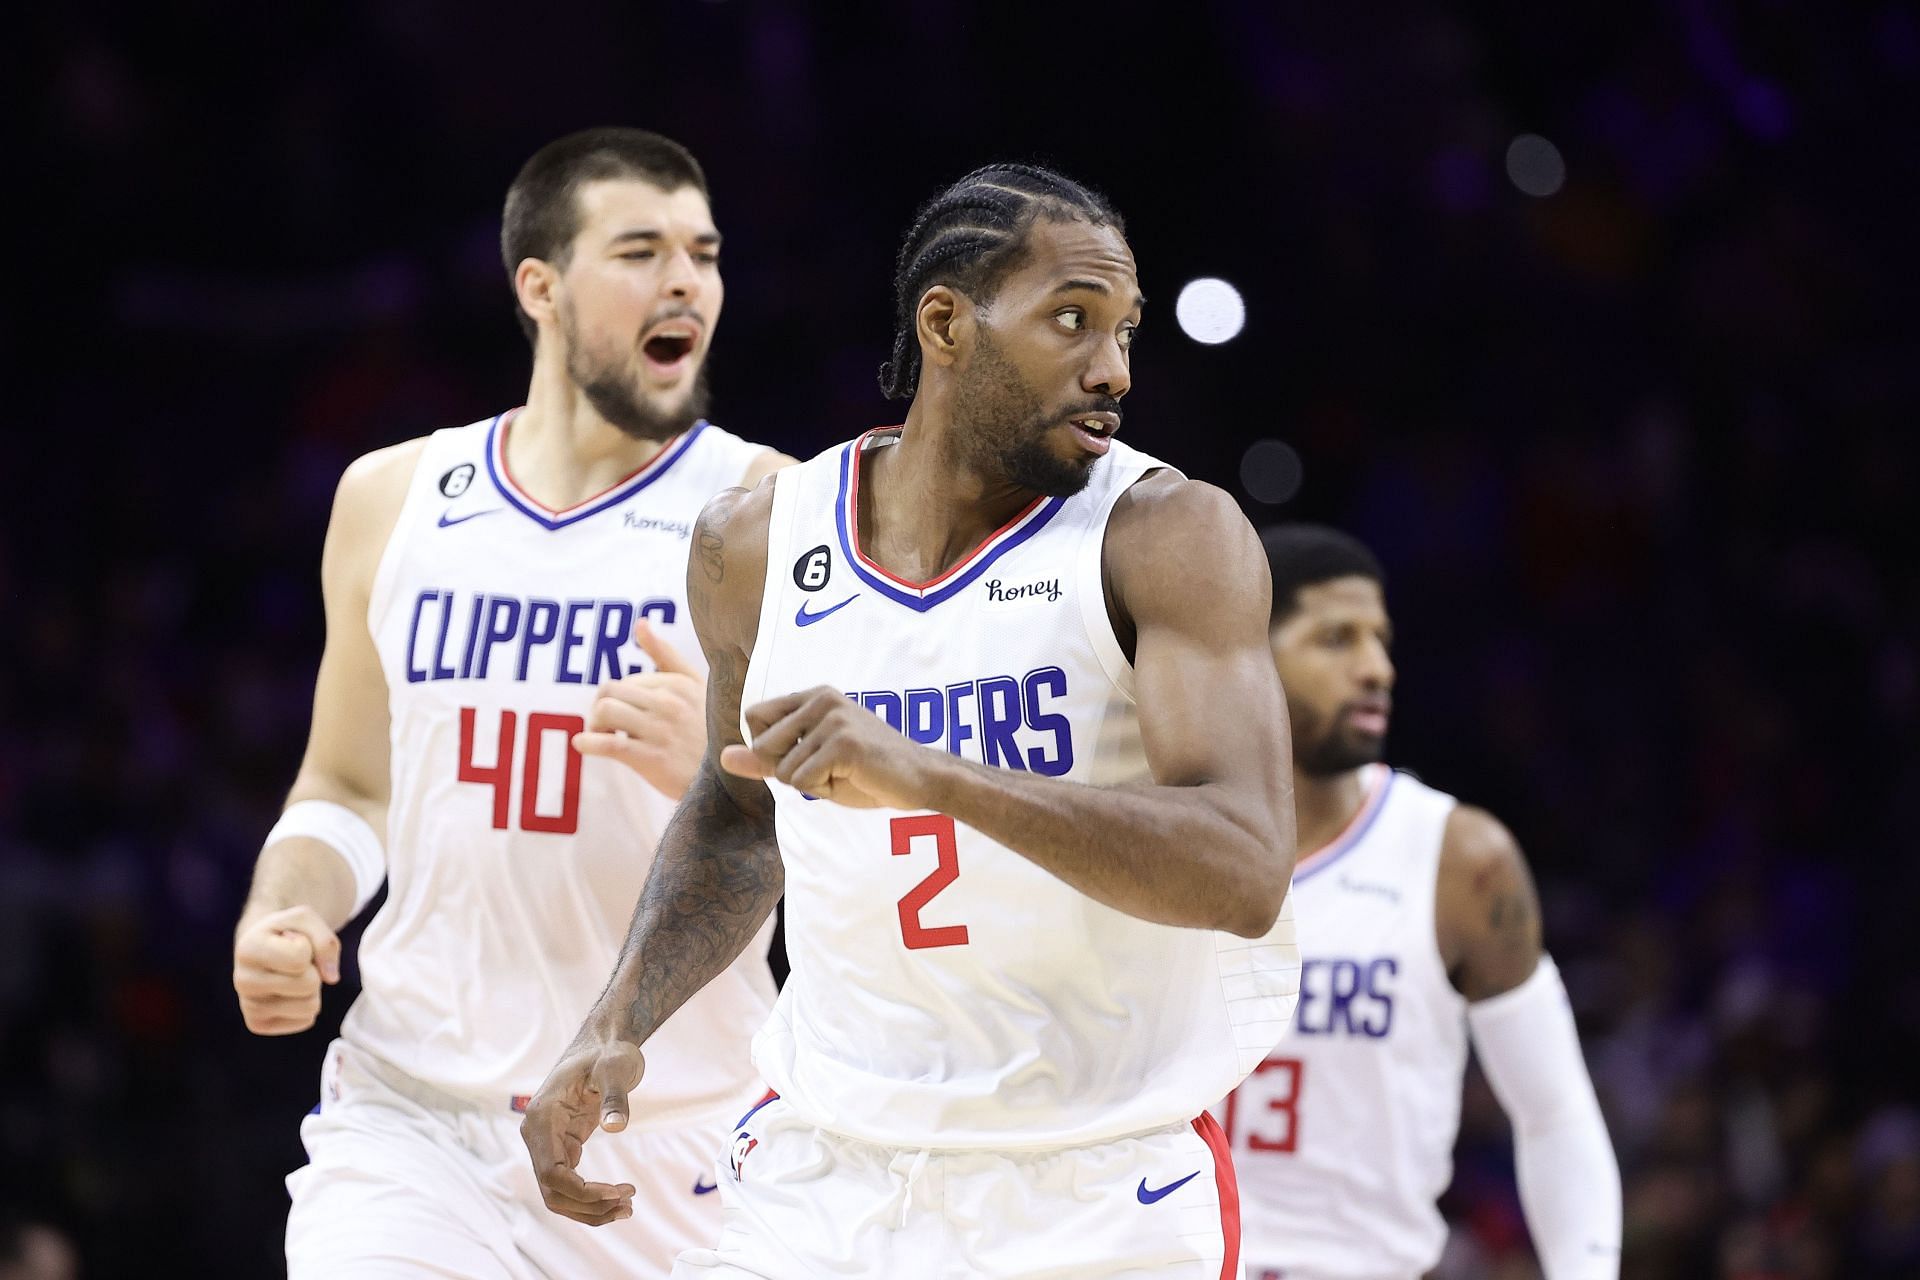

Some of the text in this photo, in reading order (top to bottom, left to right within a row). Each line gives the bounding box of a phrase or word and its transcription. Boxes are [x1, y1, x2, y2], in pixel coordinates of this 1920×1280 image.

[802, 550, 829, 589] 6
[985, 578, 1062, 602] honey
[457, 707, 585, 836] 40
[889, 813, 970, 950] 2
